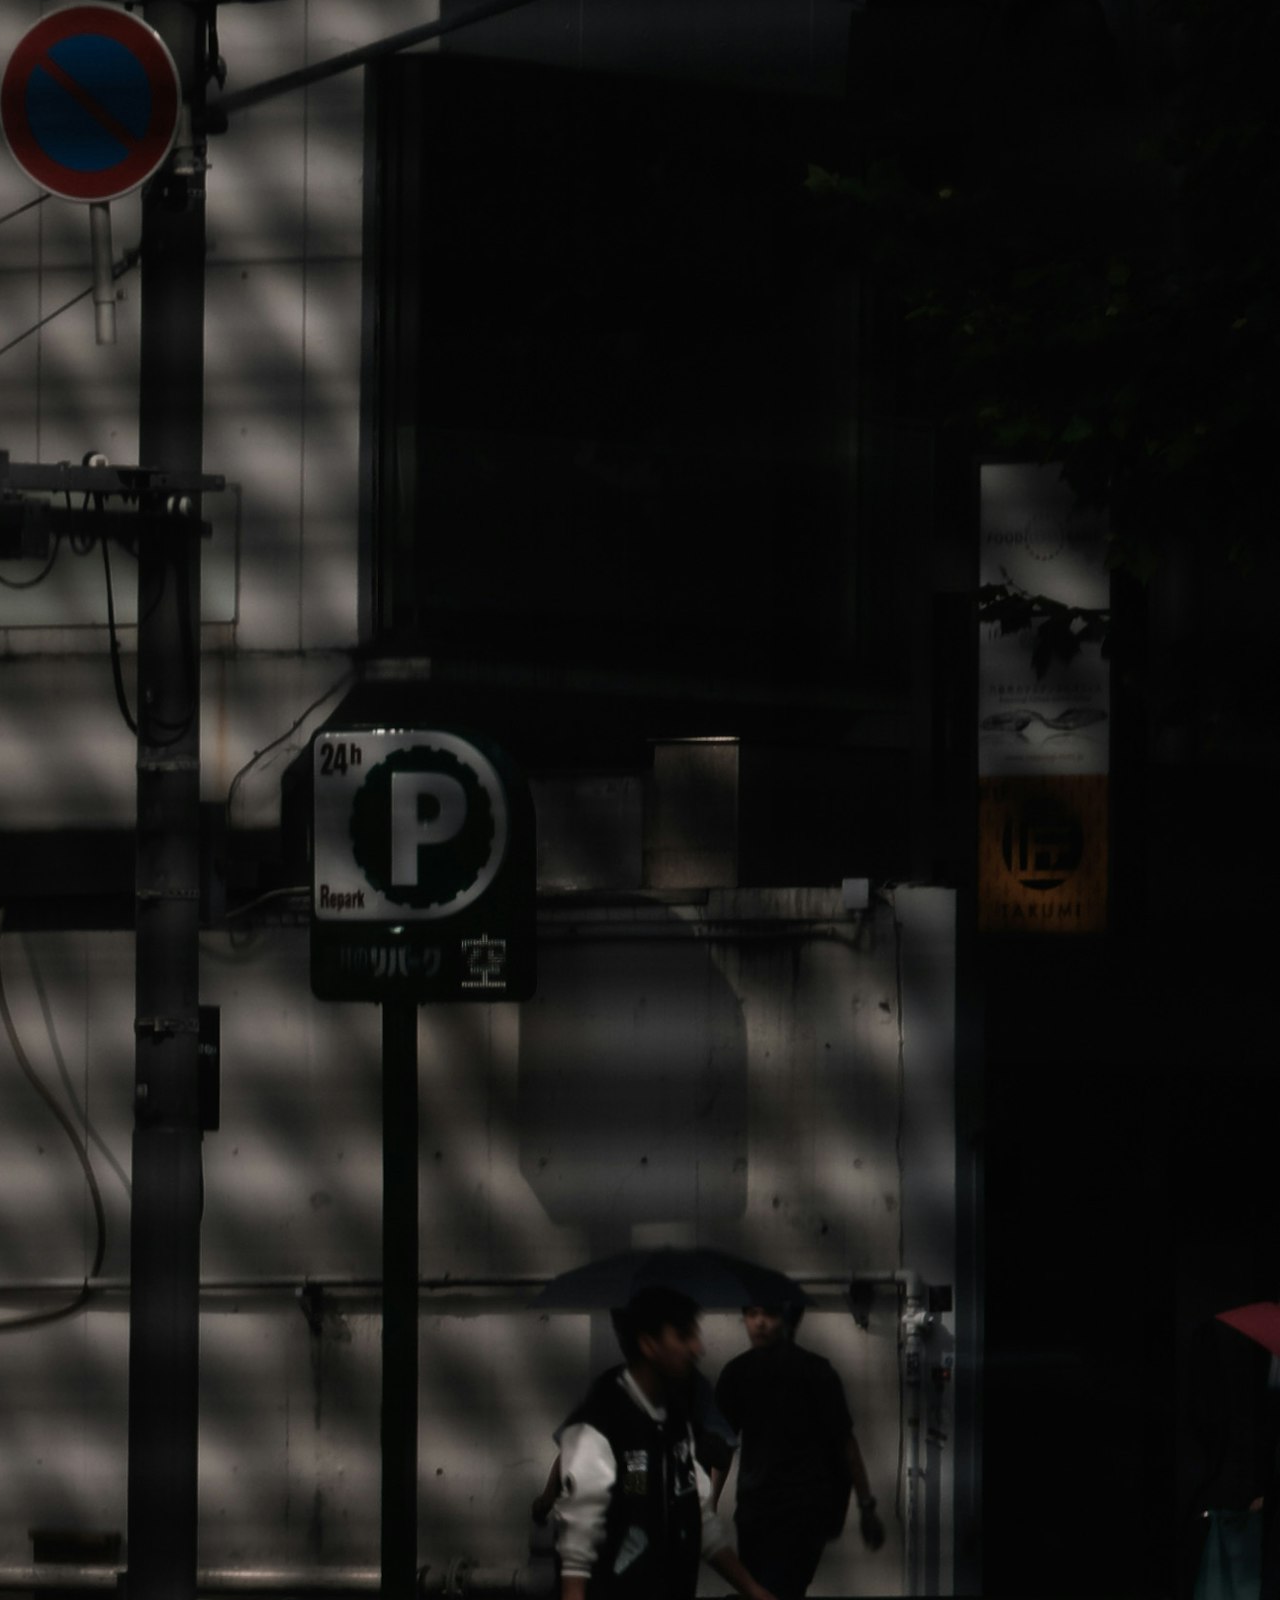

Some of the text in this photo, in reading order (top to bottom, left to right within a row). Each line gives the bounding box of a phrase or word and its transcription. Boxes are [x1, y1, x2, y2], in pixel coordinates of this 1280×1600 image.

[320, 743, 362, 776] 24h
[391, 771, 468, 888] P
[320, 884, 365, 911] Repark
[1001, 902, 1083, 919] TAKUMI
[460, 932, 507, 988] 空
